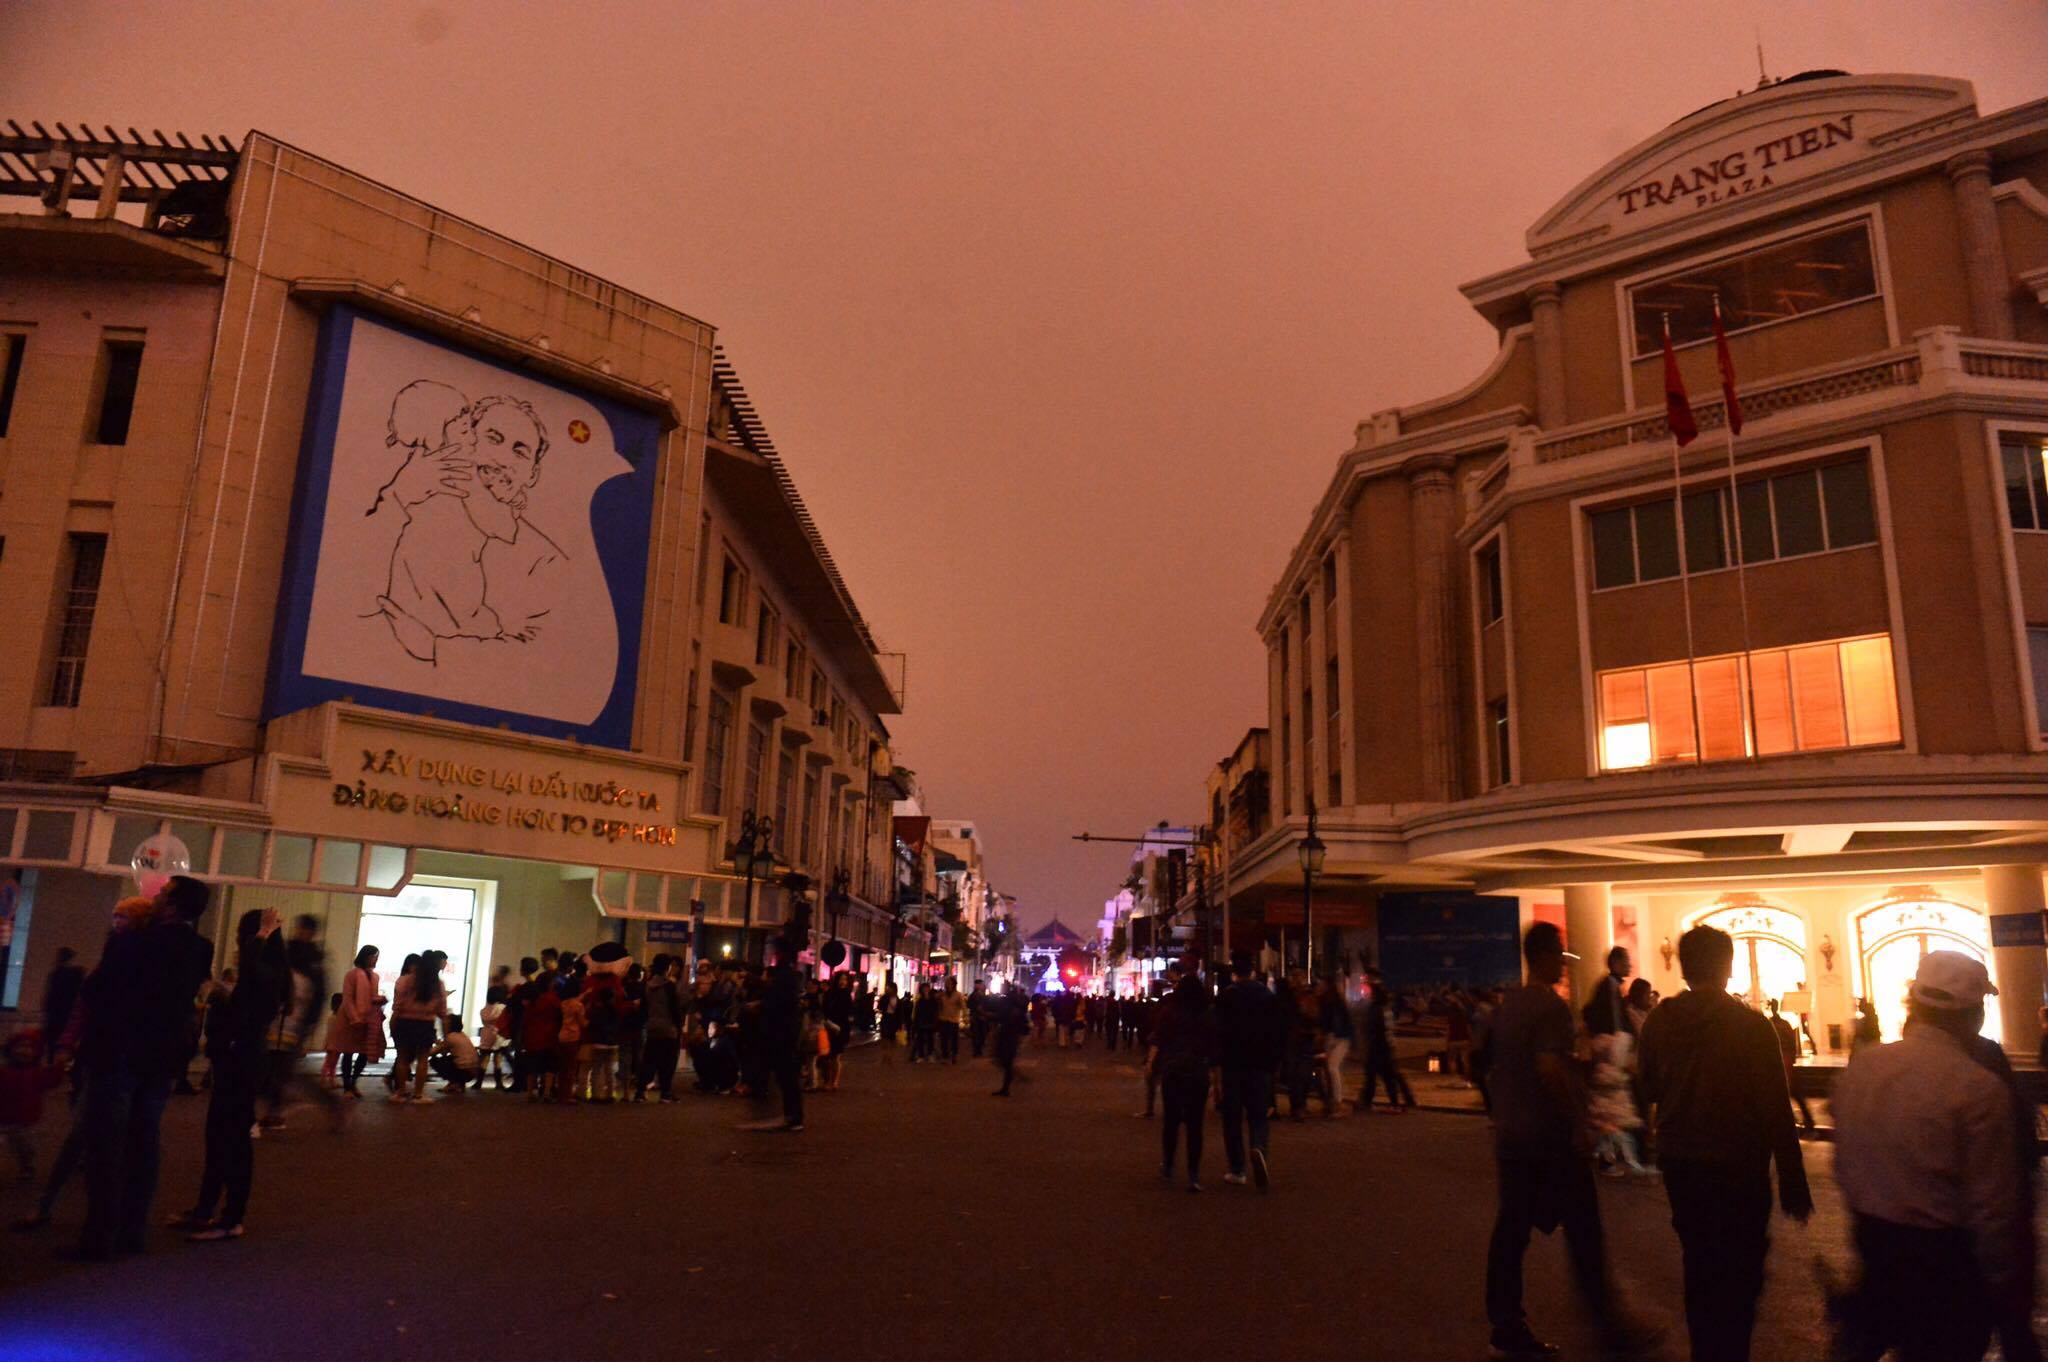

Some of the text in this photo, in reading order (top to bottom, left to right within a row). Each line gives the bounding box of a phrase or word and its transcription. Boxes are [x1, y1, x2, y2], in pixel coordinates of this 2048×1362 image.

[1618, 115, 1854, 215] TRANG TIEN
[1696, 174, 1774, 207] PLAZA
[361, 749, 416, 777] XÂY
[491, 769, 523, 795] LẠI
[637, 790, 661, 813] TA
[506, 806, 558, 832] HƠN
[561, 813, 587, 836] TO
